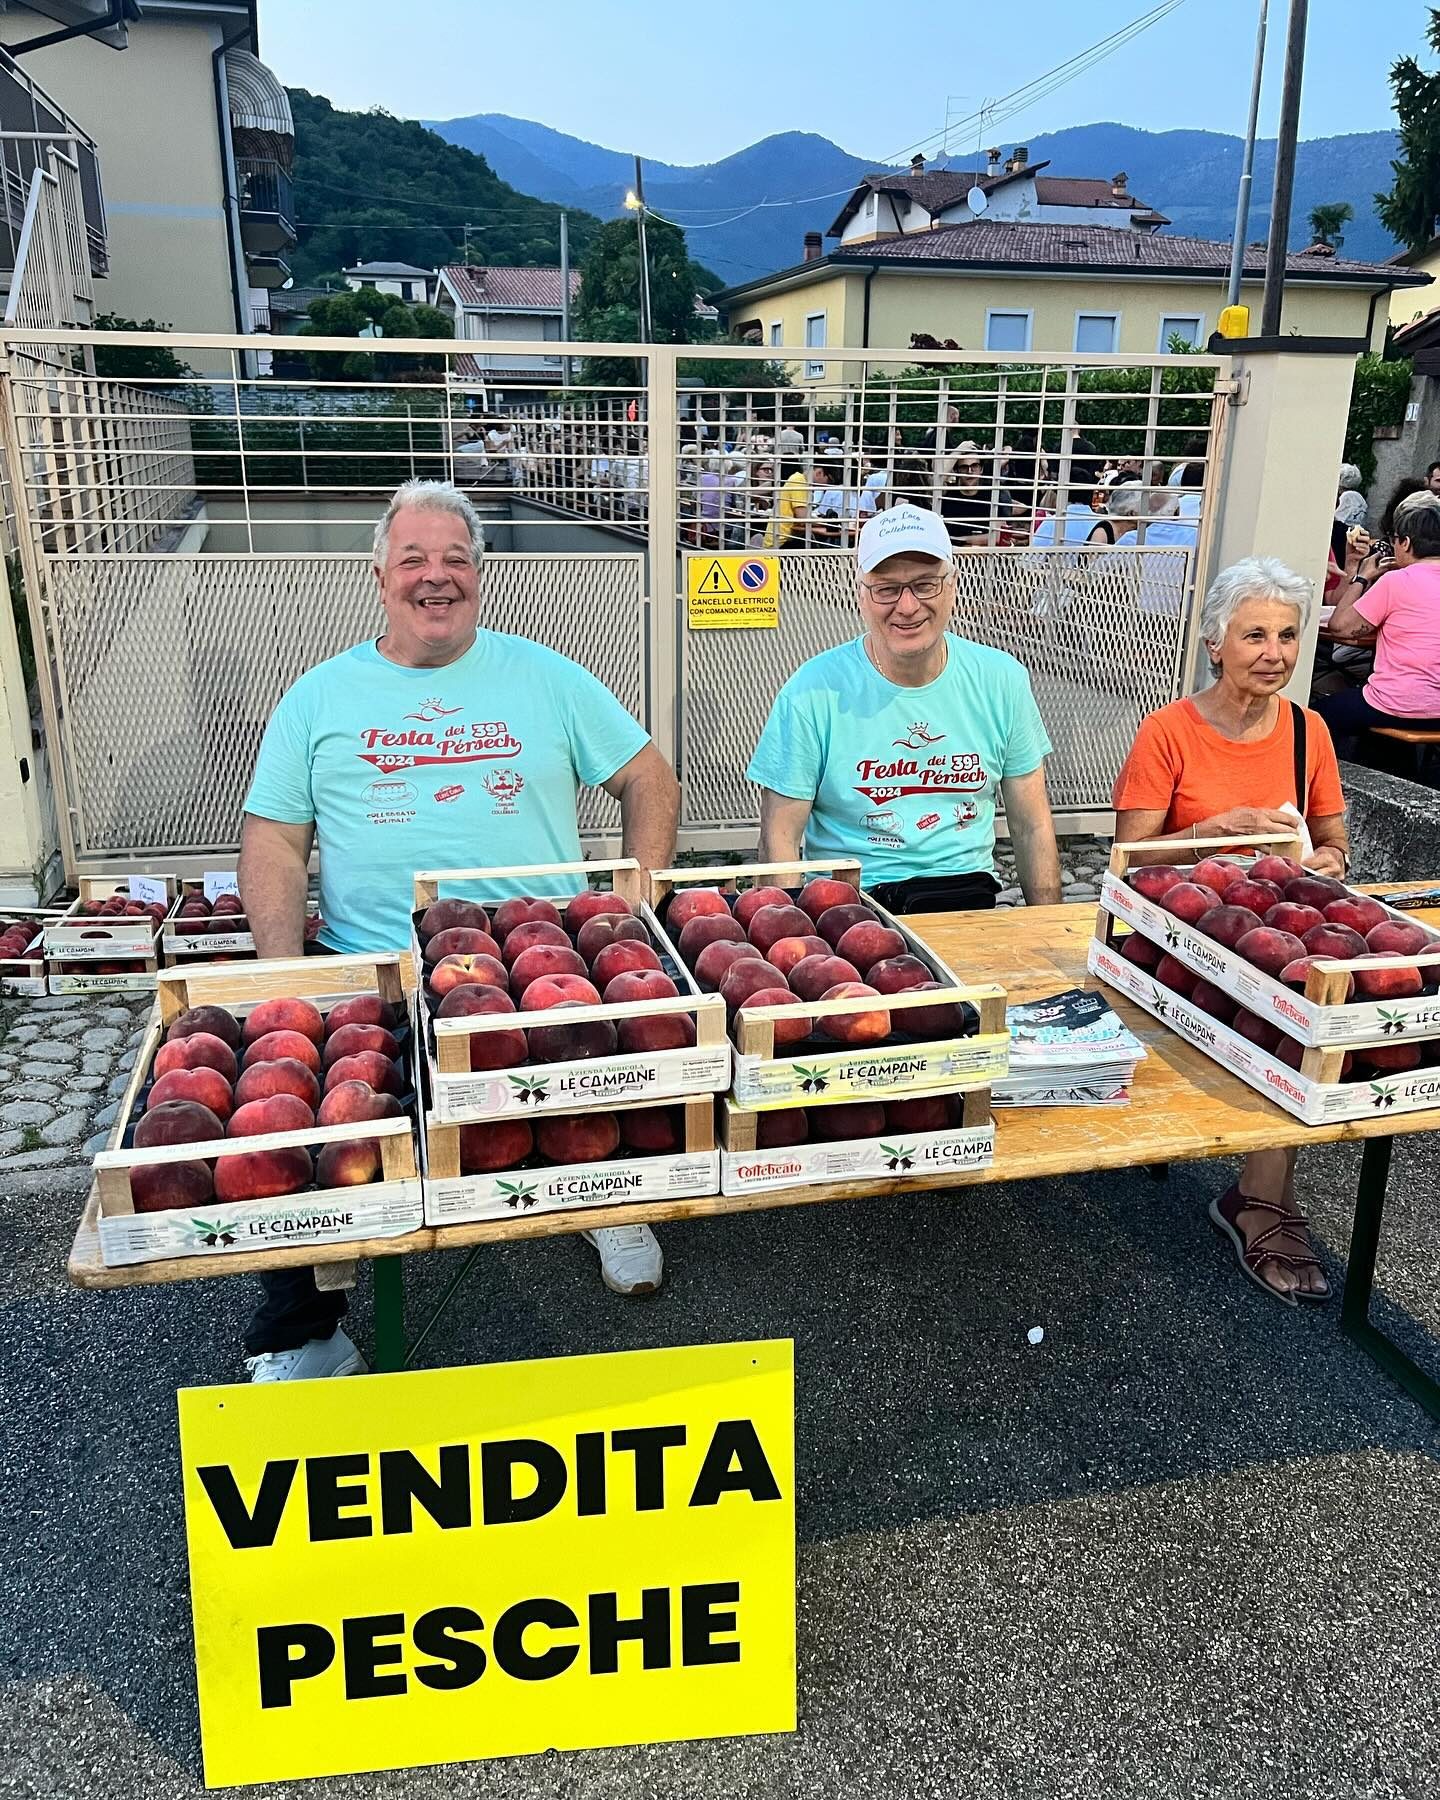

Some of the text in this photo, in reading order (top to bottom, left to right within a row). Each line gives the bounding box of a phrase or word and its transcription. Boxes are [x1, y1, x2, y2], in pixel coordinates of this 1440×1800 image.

[691, 597, 775, 606] CANCELLO ELETTRICO
[361, 728, 436, 749] Festa
[445, 724, 466, 737] dei
[436, 734, 521, 756] Pérsech
[375, 755, 416, 767] 2024
[856, 758, 919, 781] Festa
[927, 755, 947, 766] dei
[918, 768, 987, 786] Pérsech
[869, 787, 902, 798] 2024
[1183, 937, 1191, 950] LE
[1192, 943, 1227, 974] CAMPANE
[1171, 1007, 1180, 1020] LE
[1180, 1013, 1217, 1045] CAMPANE
[560, 1077, 576, 1091] LE
[579, 1068, 656, 1088] CAMPANE
[568, 1063, 644, 1077] AZIENDA AGRICOLA
[839, 1060, 928, 1080] LE CAMPANE
[1405, 1085, 1417, 1096] LE
[925, 1147, 940, 1159] LE
[592, 1170, 631, 1179] AGRICOLA
[736, 1162, 802, 1179] Collebeato
[548, 1175, 643, 1196] LE CAMPANE
[249, 1222, 267, 1235] LE
[270, 1213, 354, 1233] CAMPANE
[196, 1419, 783, 1550] VENDITA
[257, 1581, 742, 1710] PESCHE
